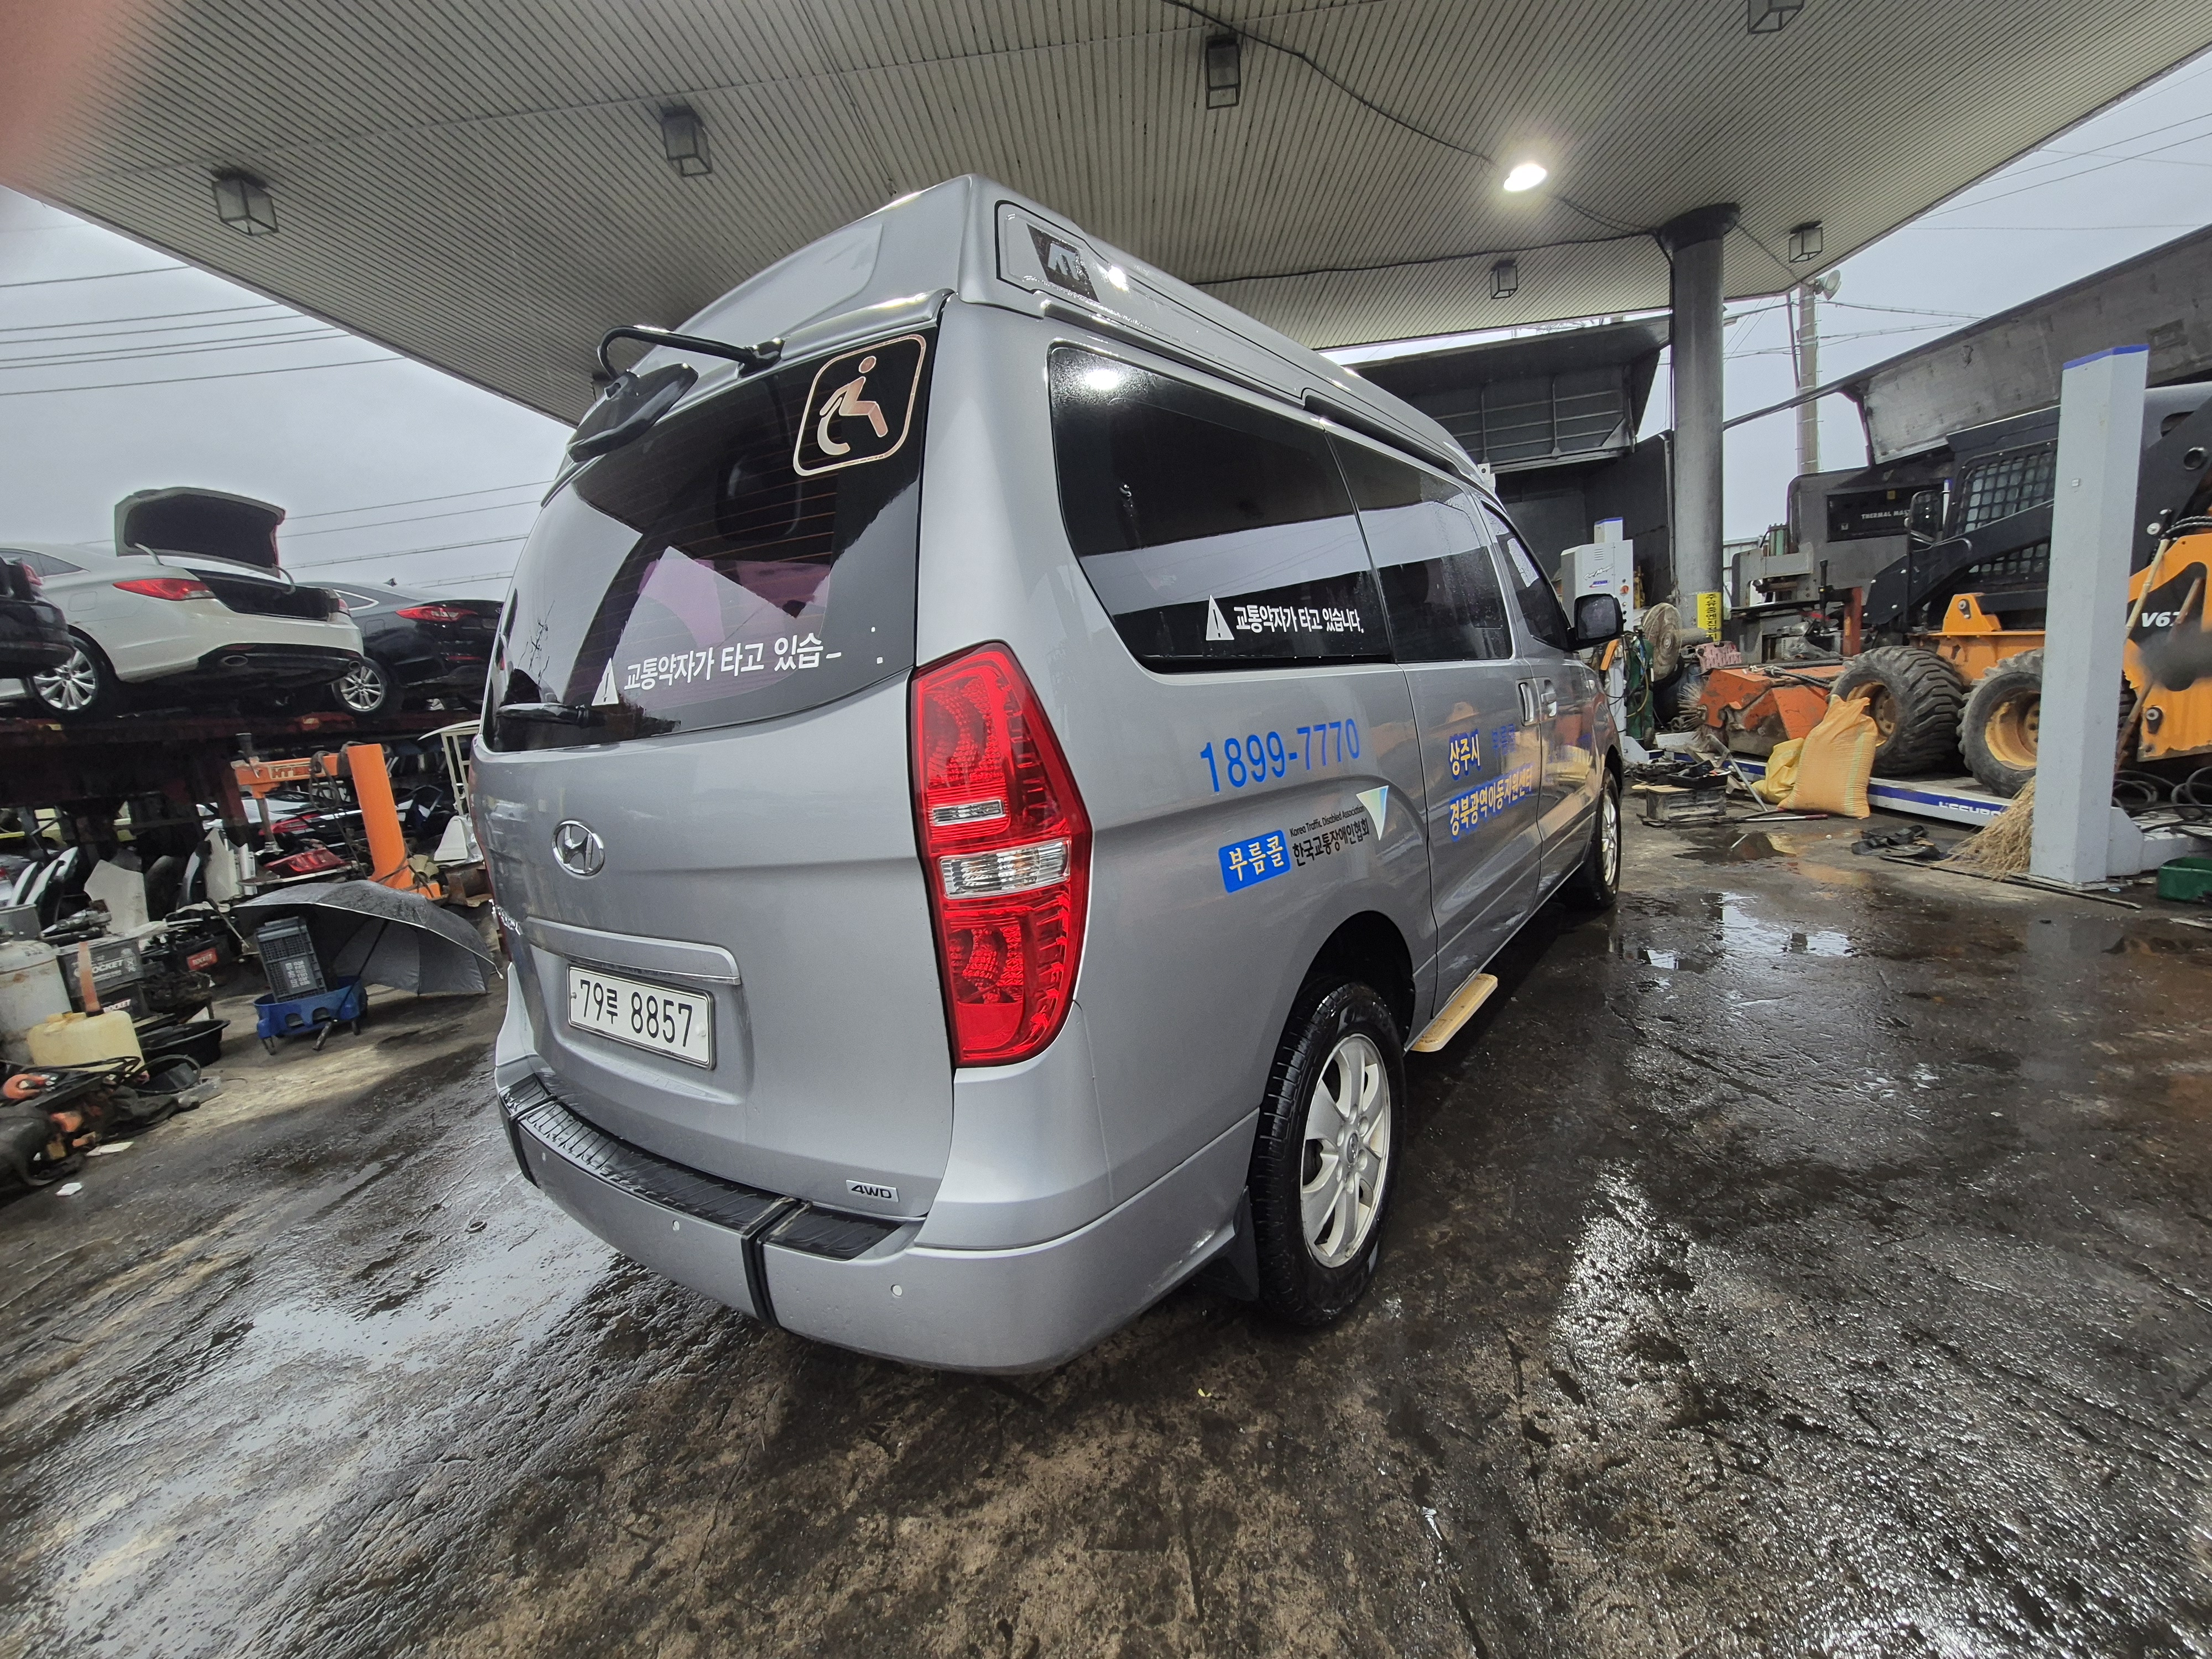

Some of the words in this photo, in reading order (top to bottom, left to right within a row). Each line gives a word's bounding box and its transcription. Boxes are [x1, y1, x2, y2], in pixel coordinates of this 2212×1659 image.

[1234, 605, 1298, 633] 교통약자가
[1298, 607, 1323, 632] 타고
[1322, 608, 1365, 633] 있습니다.
[624, 647, 714, 690] 교통약자가
[721, 642, 764, 676] 타고
[1200, 718, 1360, 792] 1899-7770
[1449, 733, 1480, 775] 상주시
[1290, 826, 1306, 837] Korea
[1322, 811, 1342, 826] Disabled
[1292, 817, 1370, 867] 한국교통장애인협회
[1229, 835, 1284, 881] 부름콜
[92, 959, 124, 974] OCKET
[580, 979, 618, 1024] 79루
[631, 992, 693, 1047] 8857
[851, 1185, 892, 1198] 4WD
